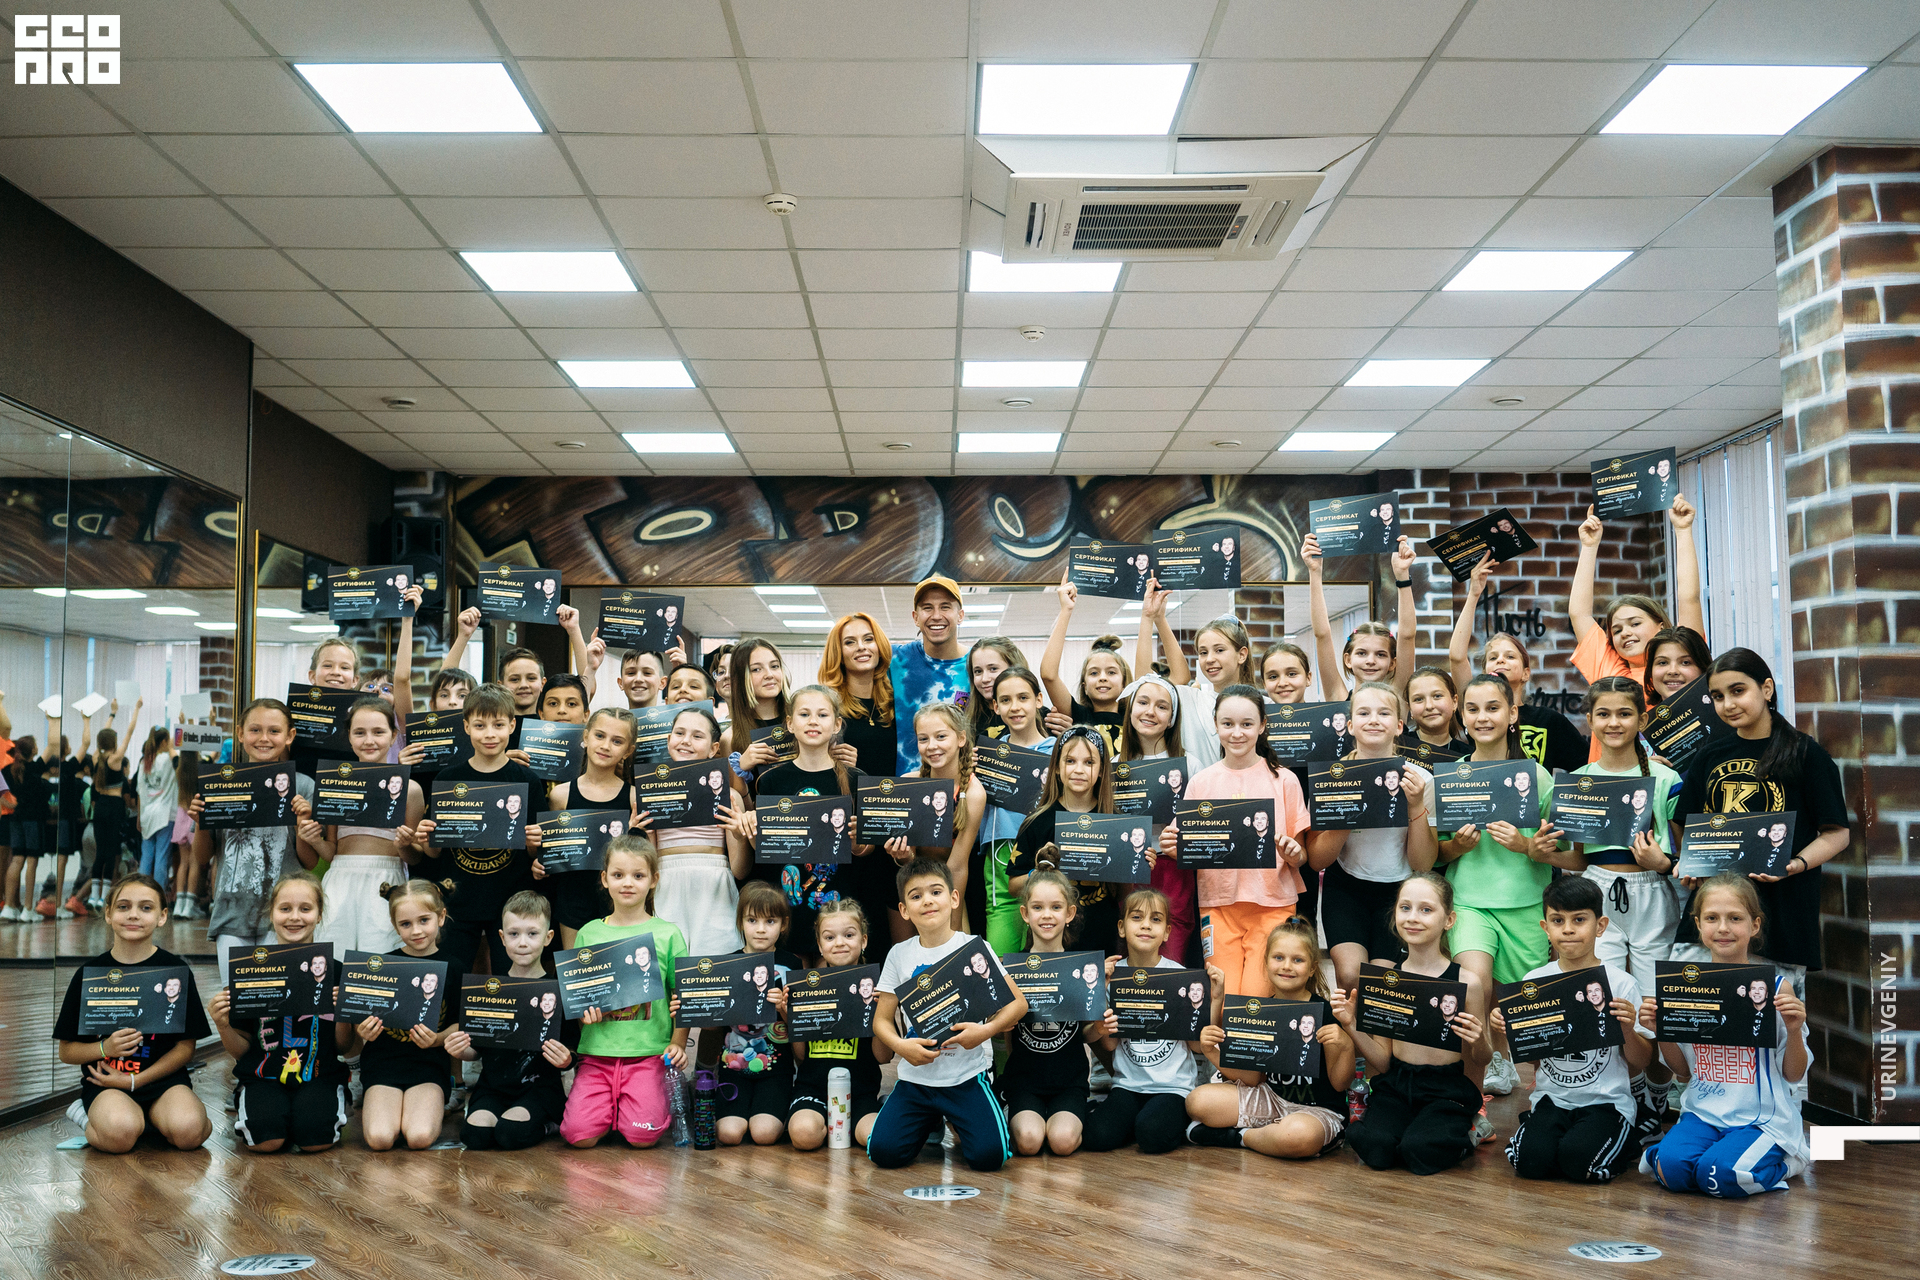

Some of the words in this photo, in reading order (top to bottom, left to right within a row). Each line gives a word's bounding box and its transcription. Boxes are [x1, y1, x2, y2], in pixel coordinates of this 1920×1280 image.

[1596, 471, 1638, 485] СЕРТИФИКАТ
[1315, 512, 1359, 523] СЕРТИФИКАТ
[1441, 533, 1482, 556] СЕРТИФИКАТ
[1158, 546, 1201, 554] СЕРТИФИКАТ
[1074, 553, 1116, 563] СЕРТИФИКАТ
[333, 580, 375, 588] СЕРТИФИКАТ
[483, 578, 524, 587] СЕРТИФИКАТ
[605, 605, 646, 615] СЕРТИФИКАТ
[1477, 581, 1546, 637] Пусть
[292, 701, 337, 712] СЕРТИФИКАТ
[1650, 708, 1693, 739] СЕРТИФИКАТ
[411, 727, 453, 737] СЕРТИФИКАТ
[525, 735, 570, 746] СЕРТИФИКАТ
[978, 755, 1022, 772] СЕРТИФИКАТ
[204, 781, 252, 790] СЕРТИФИКАТ
[320, 778, 367, 787] СЕРТИФИКАТ
[640, 780, 687, 790] СЕРТИФИКАТ
[1111, 779, 1147, 787] РТИФИКАТ
[1314, 780, 1362, 789] СЕРТИФИКАТ
[1440, 781, 1490, 789] СЕРТИФИКАТ
[863, 796, 910, 804] СЕРТИФИКАТ
[1558, 792, 1609, 802] СЕРТИФИКАТ
[436, 800, 484, 808] СЕРТИФИКАТ
[542, 826, 588, 836] СЕРТИФИКАТ
[1060, 831, 1108, 840] СЕРТИФИКАТ
[1690, 830, 1743, 838] СЕРТИФИКАТ
[235, 965, 287, 975] СЕРТИФИКАТ
[563, 962, 612, 977] СЕРТИФИКАТ
[347, 972, 398, 984] СЕРТИФИКАТ
[681, 976, 730, 984] СЕРТИФИКАТ
[792, 988, 837, 998] СЕРТИФИКАТ
[1116, 988, 1165, 996] СЕРТИФИКАТ
[1365, 985, 1416, 1001] СЕРТИФИКАТ
[1662, 985, 1721, 994] СЕРТИФИКАТ
[467, 995, 517, 1005] СЕРТИФИКАТ
[910, 979, 953, 1011] СЕРТИФИКАТ
[1507, 998, 1561, 1015] СЕРТИФИКАТ
[1228, 1016, 1277, 1027] СЕРТИФИКАТ
